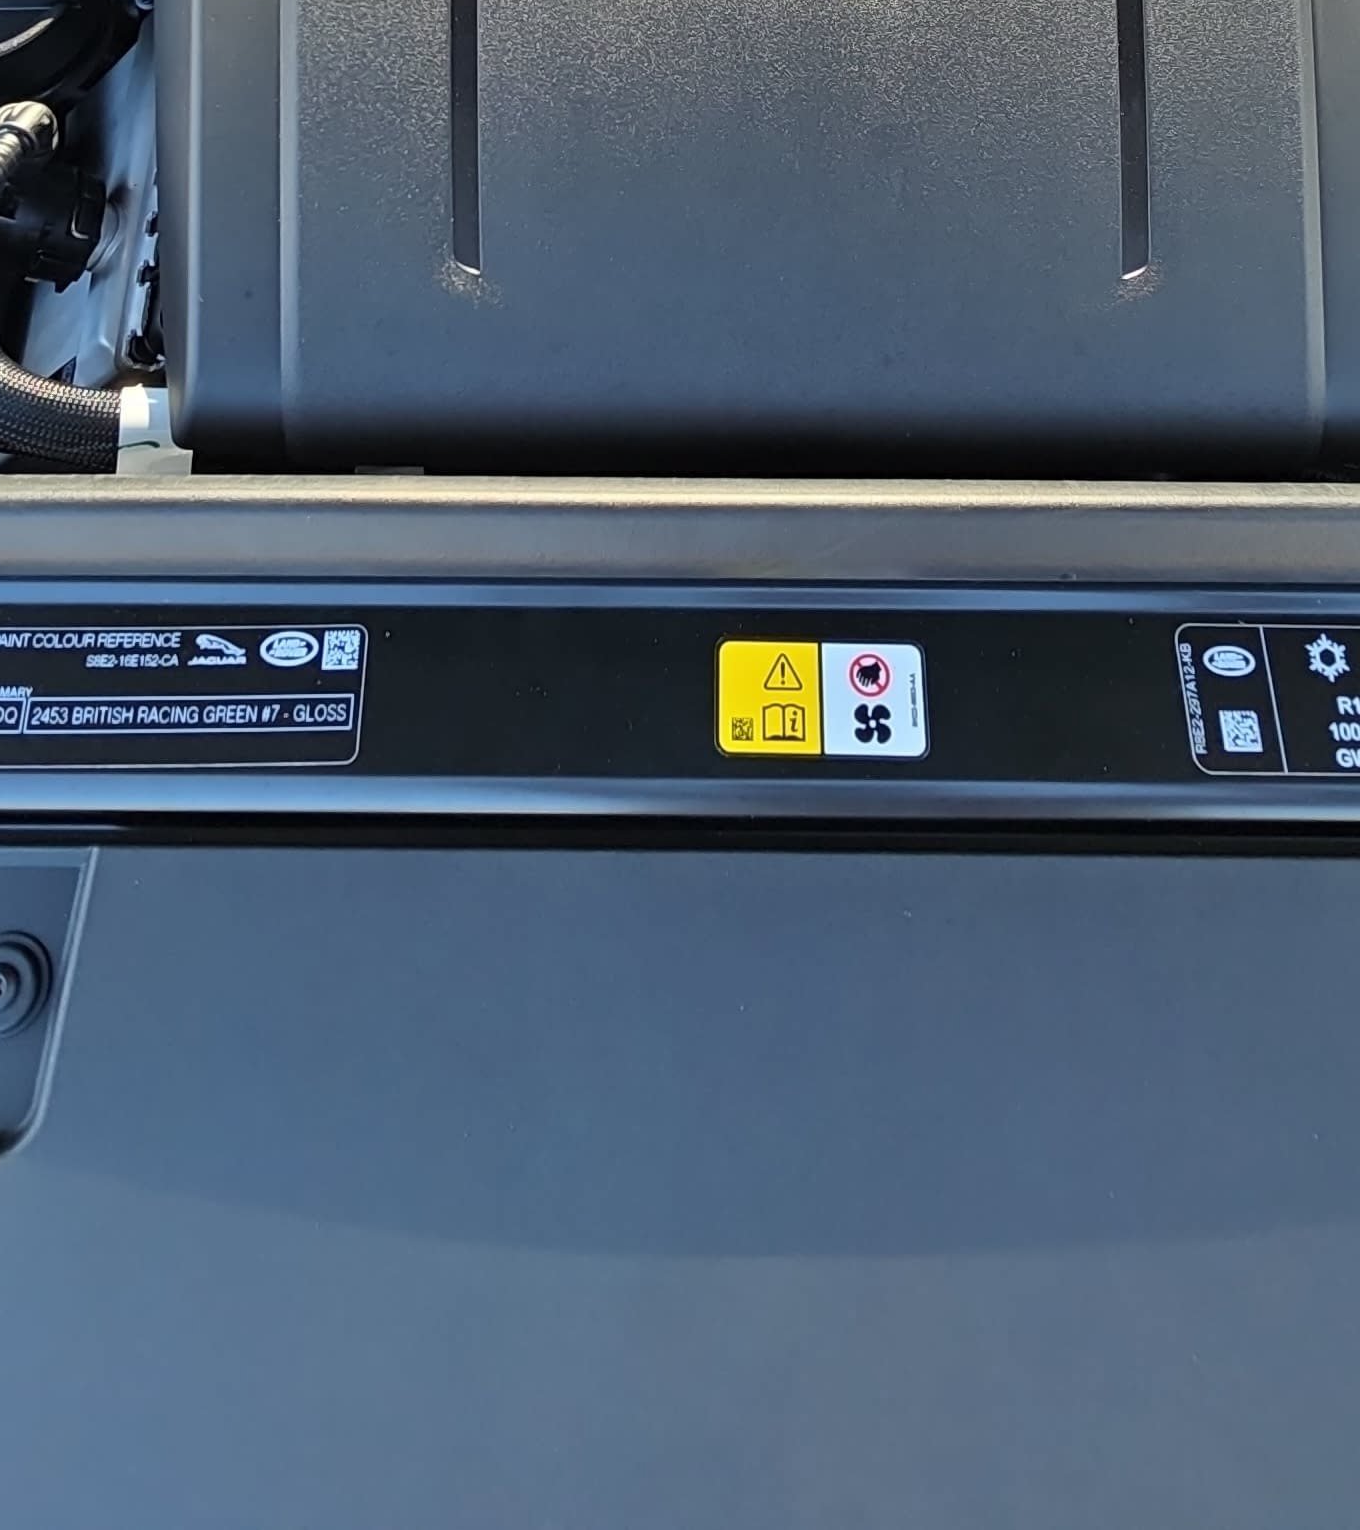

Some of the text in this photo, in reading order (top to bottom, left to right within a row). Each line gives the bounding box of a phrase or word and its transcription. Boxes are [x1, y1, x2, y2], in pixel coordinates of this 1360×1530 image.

[32, 633, 96, 649] COLOUR
[96, 631, 182, 648] REFERENCE
[30, 706, 69, 726] 2453
[71, 705, 135, 726] BRITISH
[136, 705, 199, 725] RACING
[202, 704, 258, 724] GREEN
[261, 703, 281, 723] #7
[292, 703, 348, 723] GLOSS
